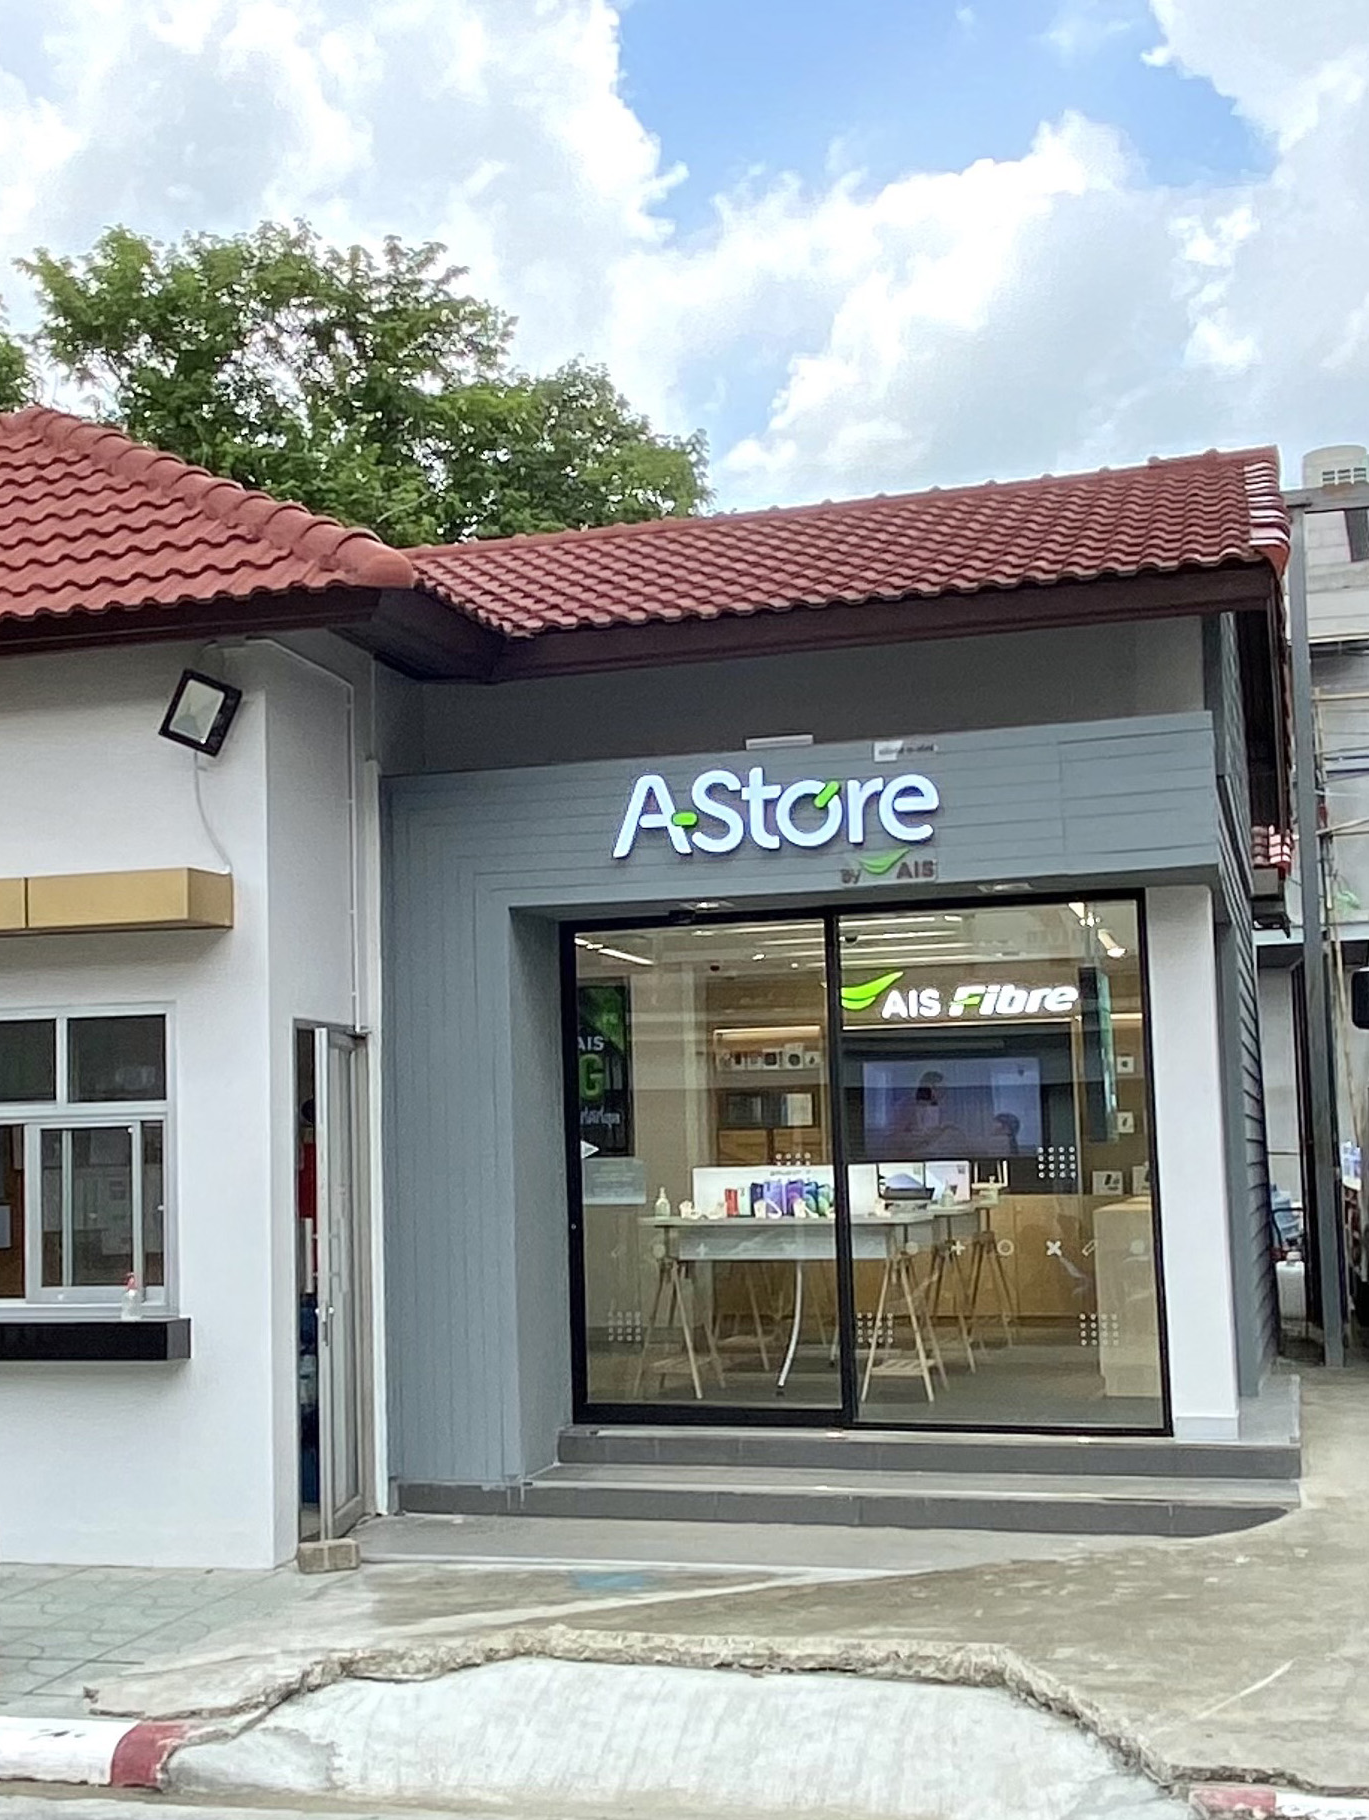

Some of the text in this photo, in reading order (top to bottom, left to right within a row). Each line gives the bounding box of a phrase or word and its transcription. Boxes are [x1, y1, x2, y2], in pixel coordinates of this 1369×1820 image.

[896, 860, 934, 879] AIS
[882, 984, 1078, 1019] AIS Fibre
